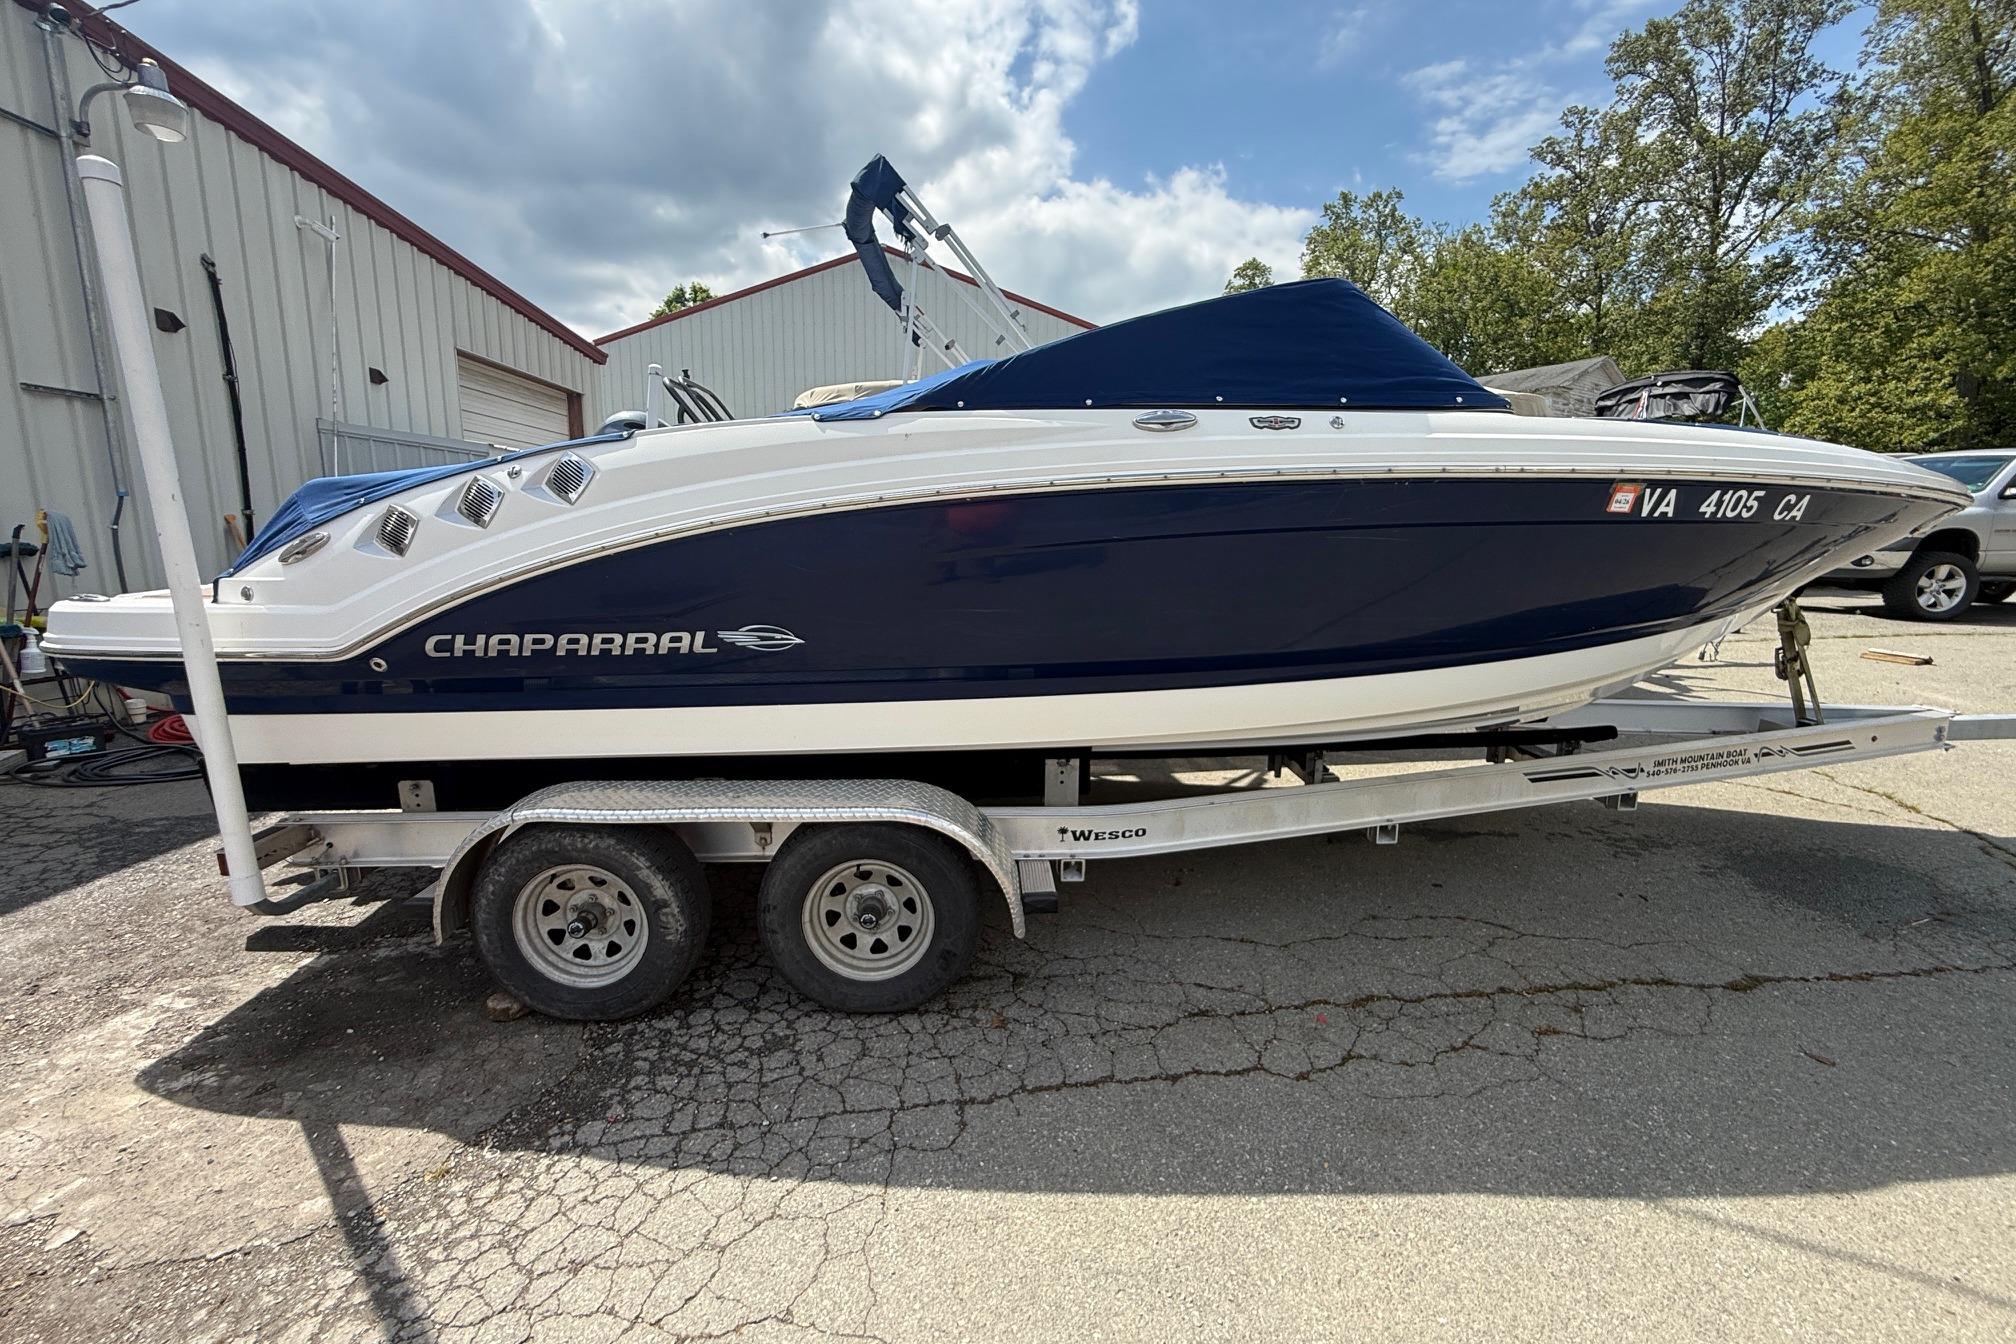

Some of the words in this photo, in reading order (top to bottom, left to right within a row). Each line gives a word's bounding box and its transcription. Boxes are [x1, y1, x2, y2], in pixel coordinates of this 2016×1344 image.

[1641, 488, 1677, 518] VA
[1699, 489, 1766, 519] 4105
[1773, 494, 1811, 521] CA
[424, 631, 718, 658] CHAPARRAL
[1646, 765, 1699, 778] 540-576-2755
[1700, 759, 1740, 771] PENHOOK
[1741, 757, 1751, 765] VA
[1653, 756, 1678, 768] SMITH
[1680, 751, 1725, 764] MOUNTAIN
[1725, 748, 1748, 759] BOAT
